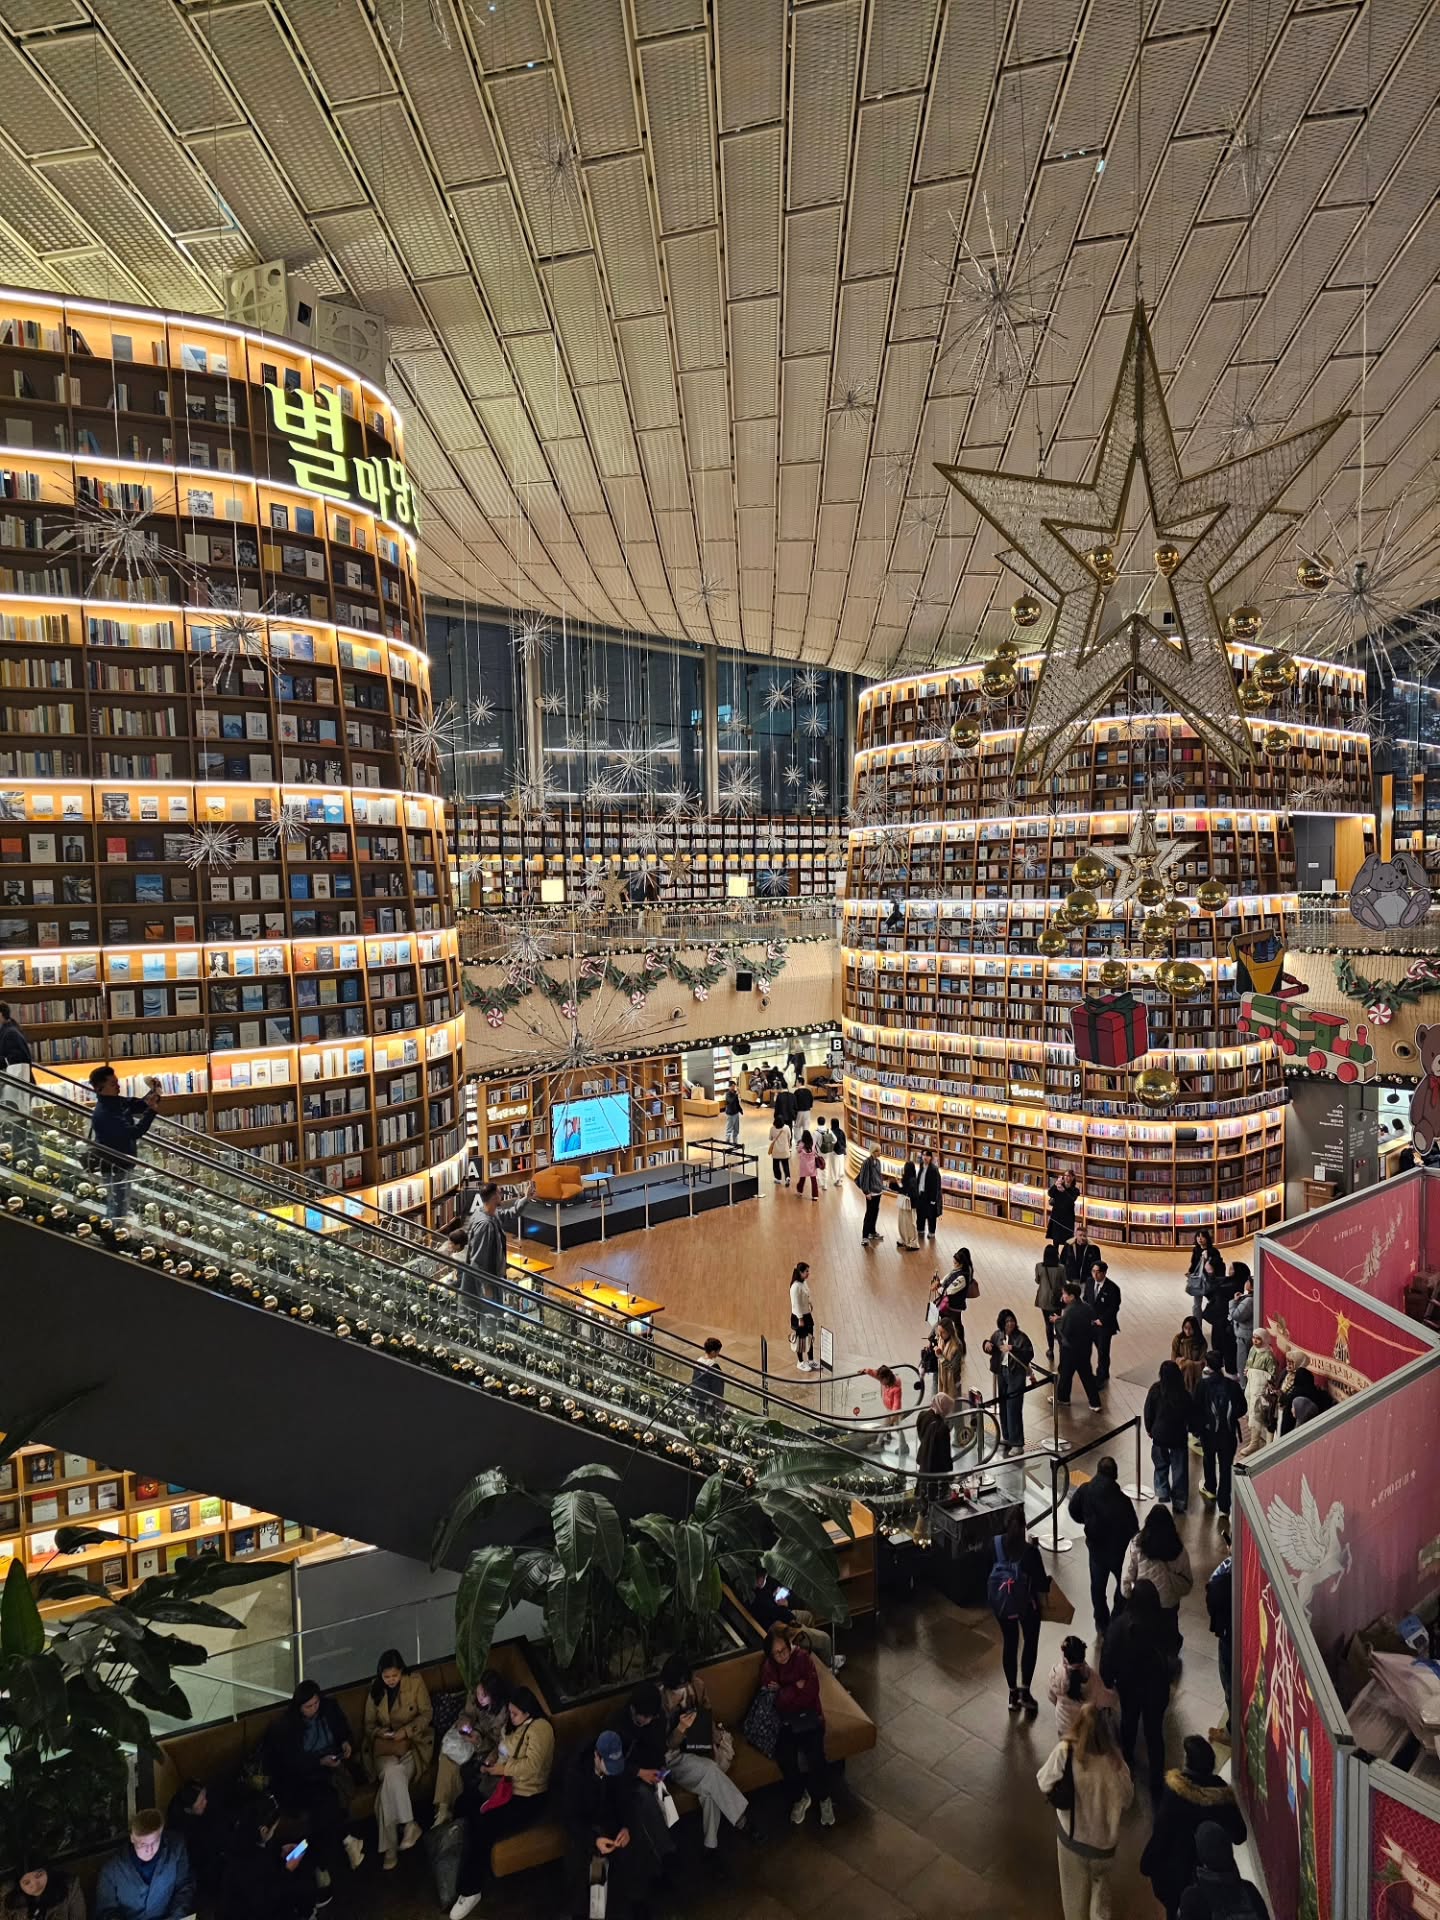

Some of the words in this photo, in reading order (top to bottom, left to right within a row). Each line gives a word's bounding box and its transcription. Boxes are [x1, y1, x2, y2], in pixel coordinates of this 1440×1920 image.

[834, 1039, 841, 1050] B
[1074, 1074, 1080, 1087] B
[468, 1161, 480, 1178] A
